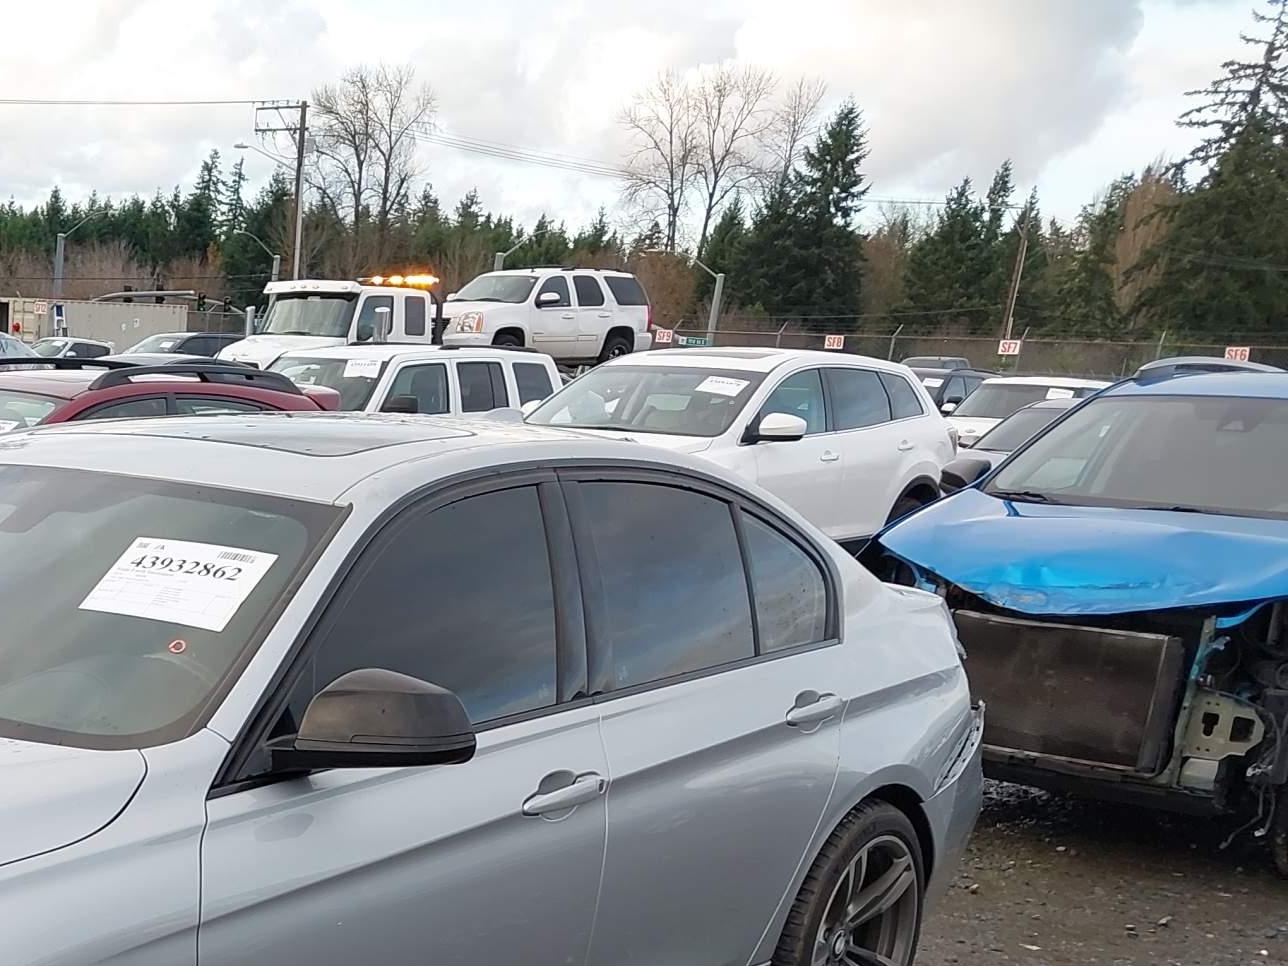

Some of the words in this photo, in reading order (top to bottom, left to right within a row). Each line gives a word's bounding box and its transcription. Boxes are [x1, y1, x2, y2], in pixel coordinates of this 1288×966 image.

[657, 331, 672, 341] SF9
[827, 336, 842, 348] SF8
[1001, 341, 1018, 353] SF7
[1227, 348, 1248, 361] SF6
[130, 554, 243, 582] 43932862
